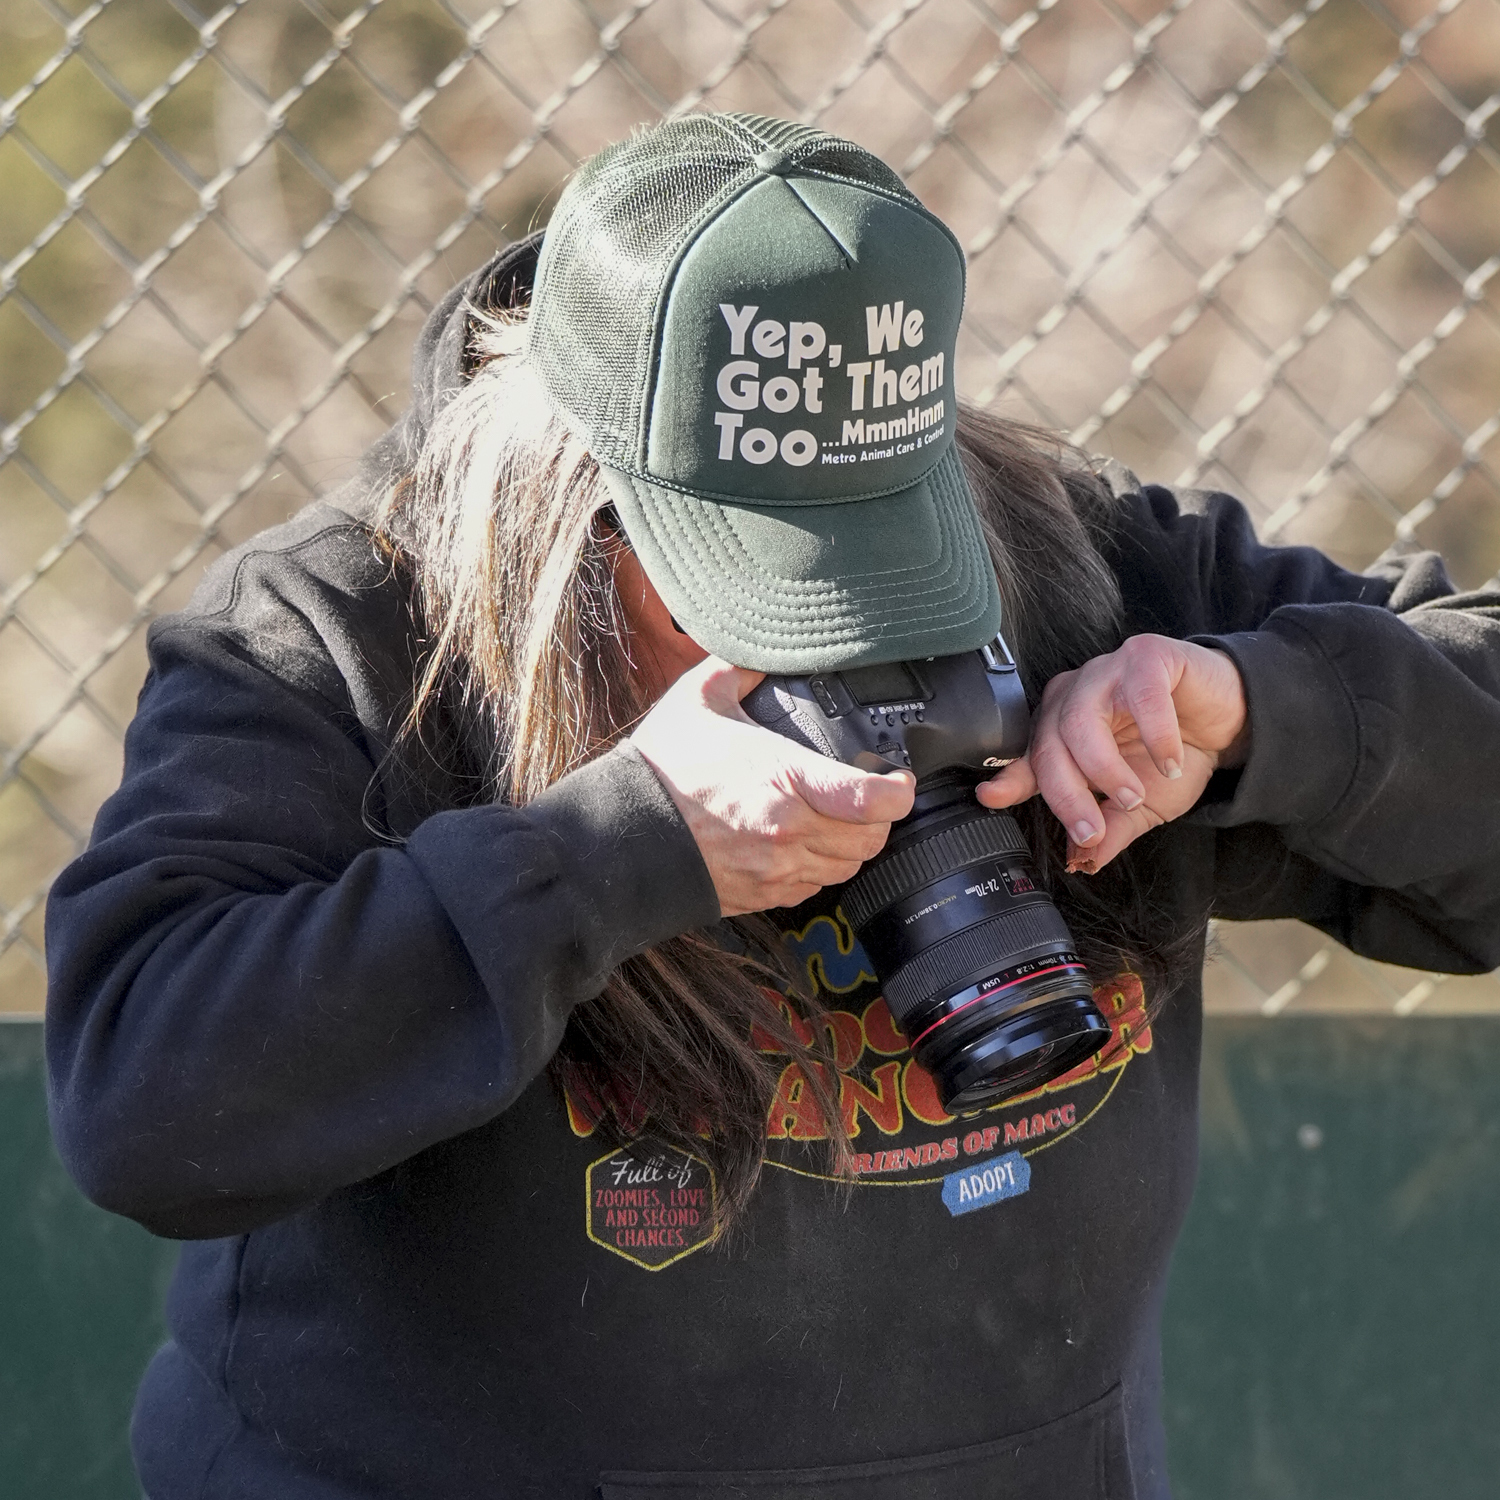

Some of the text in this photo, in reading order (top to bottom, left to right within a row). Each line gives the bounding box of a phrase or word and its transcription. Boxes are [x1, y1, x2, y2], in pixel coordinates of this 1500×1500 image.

[719, 300, 924, 369] Yep, We
[716, 351, 945, 414] Got Them
[714, 411, 818, 466] Too
[821, 423, 945, 465] Metro Animal Care & Control
[965, 878, 1000, 897] 24-70mm
[982, 977, 1001, 990] USM
[1016, 963, 1035, 975] 1:2.8
[833, 1103, 1076, 1175] FRIENDS OF MACC
[610, 1154, 694, 1189] Full of
[959, 1161, 1015, 1202] ADOPT
[595, 1188, 706, 1209] ZOOMIES, LOVE
[605, 1208, 699, 1227] AND SECOND
[616, 1228, 688, 1247] CHANCES.
